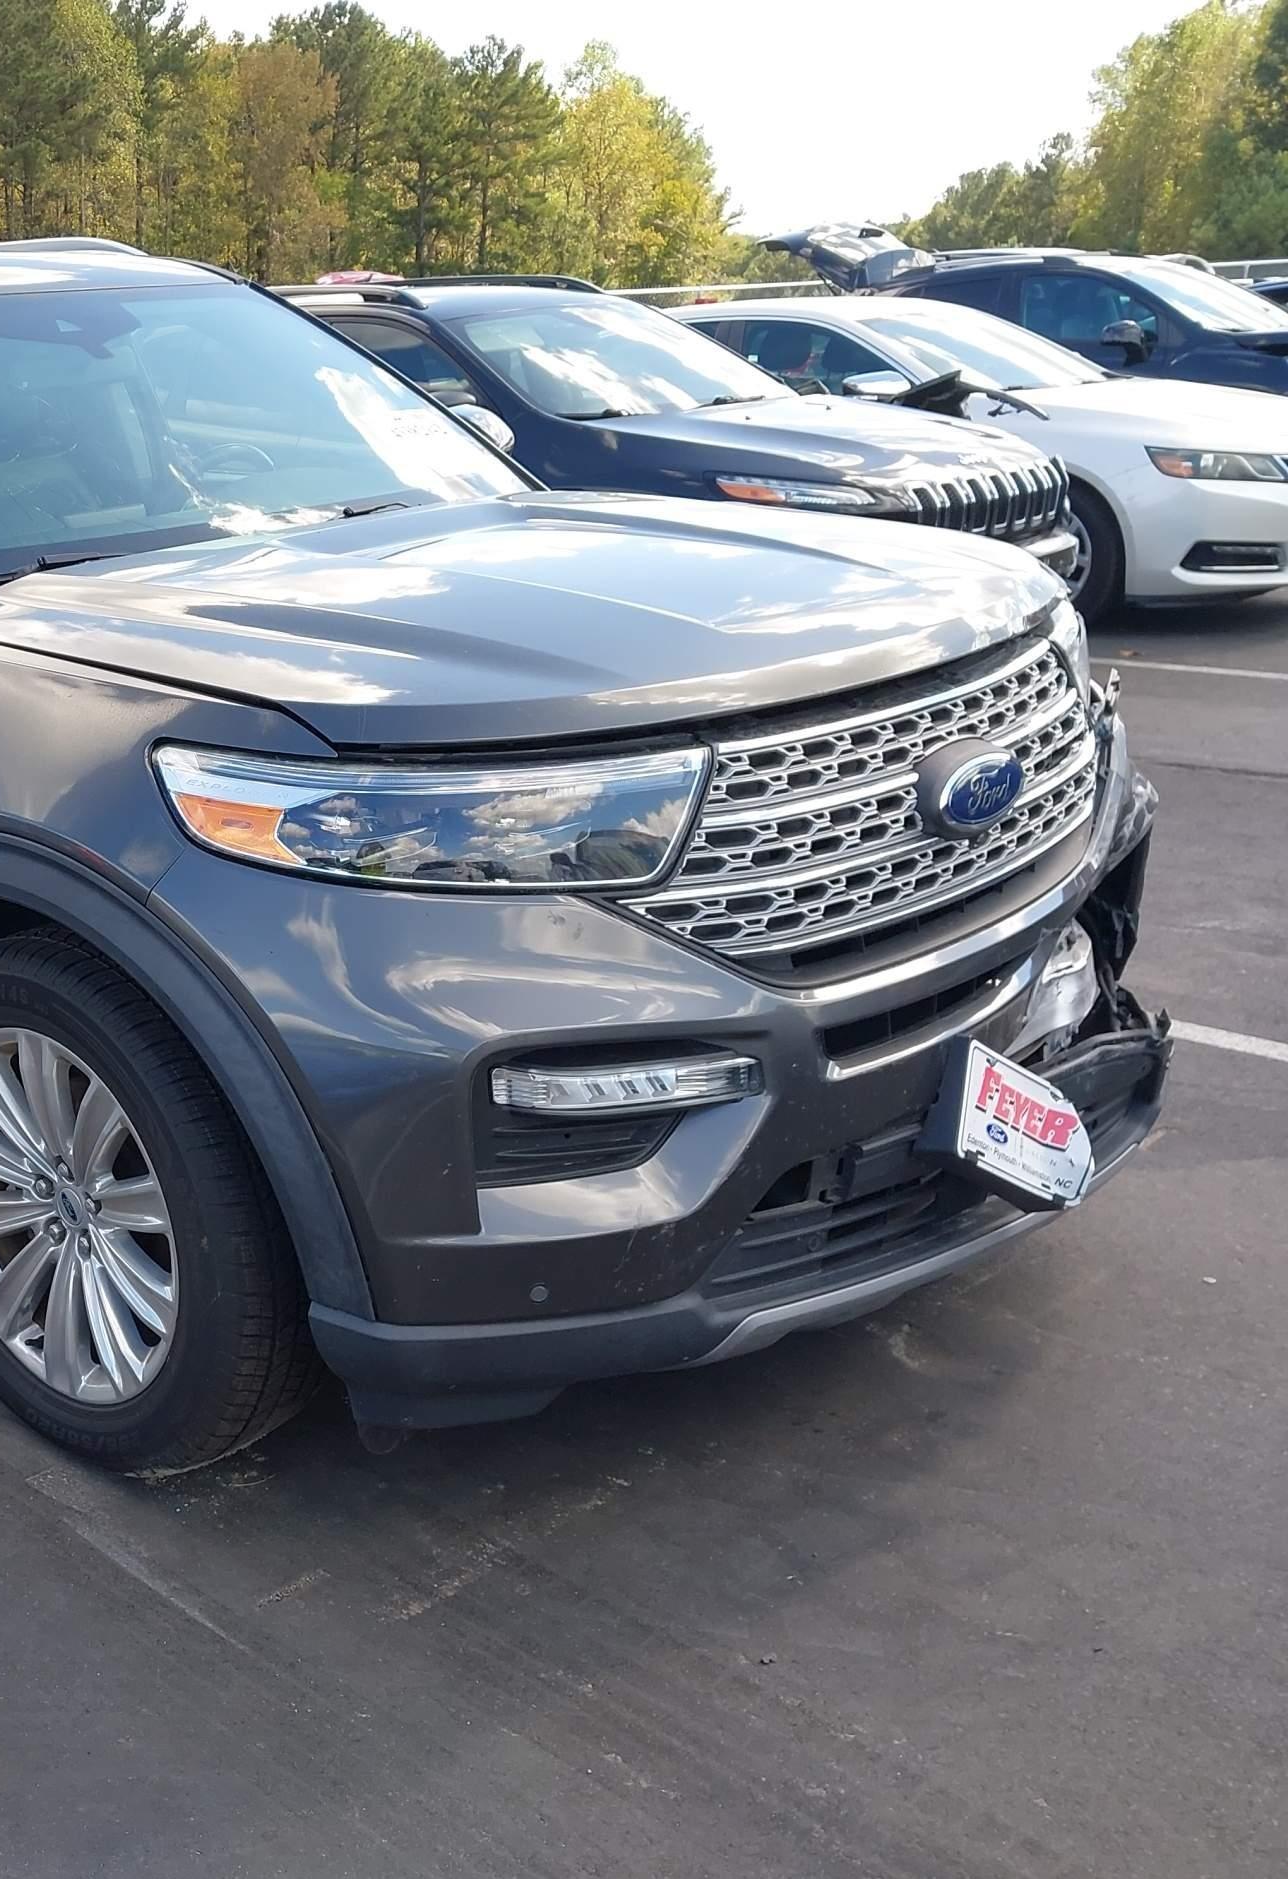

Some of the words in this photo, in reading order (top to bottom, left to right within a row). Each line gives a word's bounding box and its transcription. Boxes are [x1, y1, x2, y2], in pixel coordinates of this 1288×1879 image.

[967, 767, 1011, 815] Ford
[975, 1065, 1081, 1152] FEYER
[987, 1125, 1007, 1143] Ford
[1054, 1177, 1073, 1190] NC
